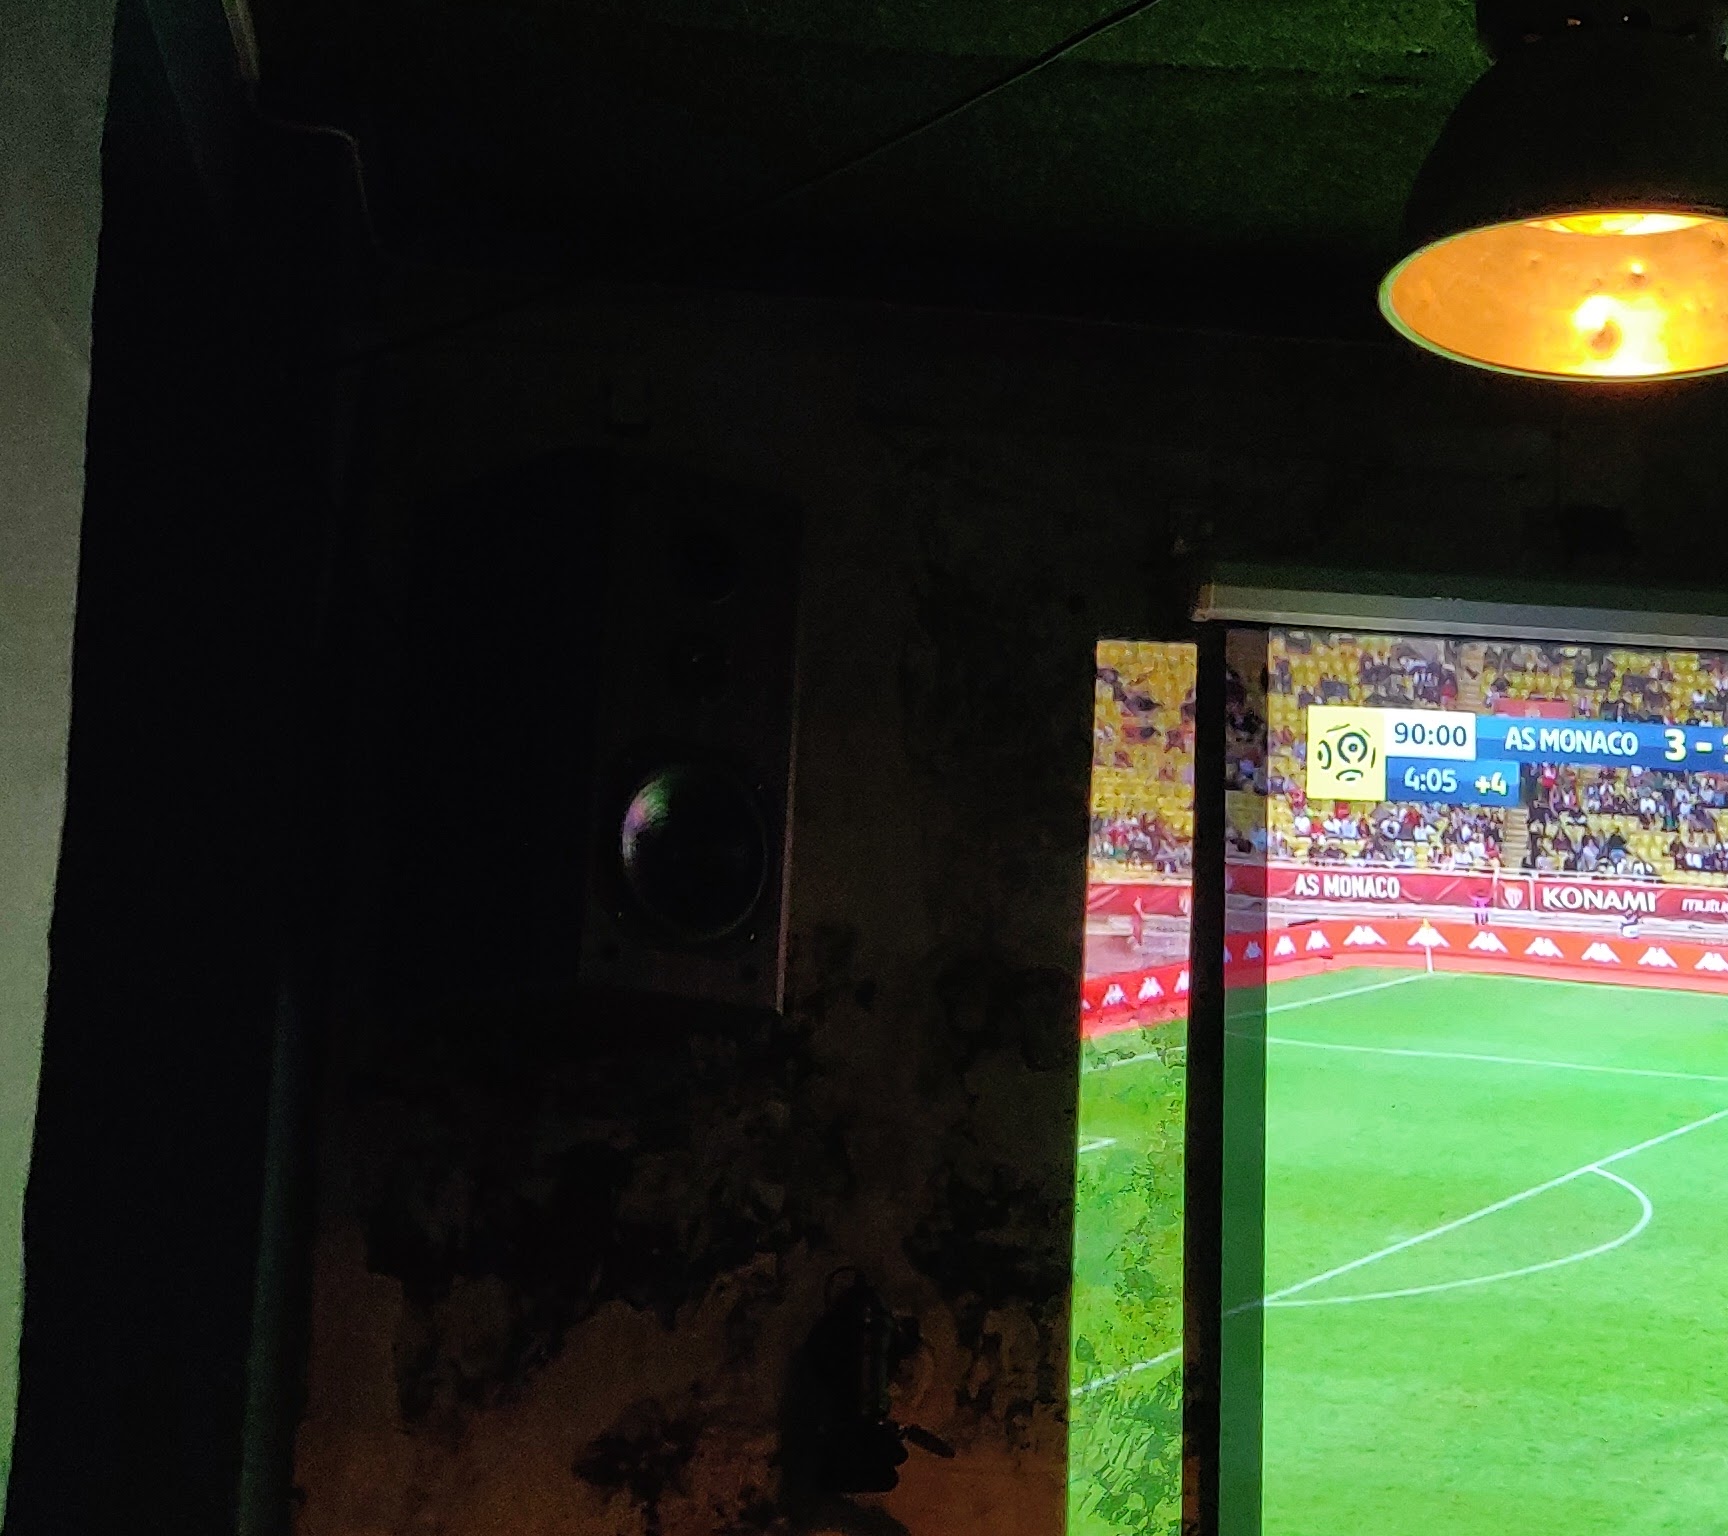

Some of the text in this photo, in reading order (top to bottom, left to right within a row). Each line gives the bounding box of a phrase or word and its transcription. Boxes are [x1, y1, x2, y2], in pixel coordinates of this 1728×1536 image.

[1394, 722, 1467, 747] 90:00
[1505, 726, 1536, 752] AS
[1540, 727, 1639, 756] MONACO
[1664, 728, 1687, 762] 3
[1404, 766, 1507, 796] 4:05 +4
[1295, 873, 1400, 899] AS MONACO
[1542, 886, 1657, 913] KONAMI
